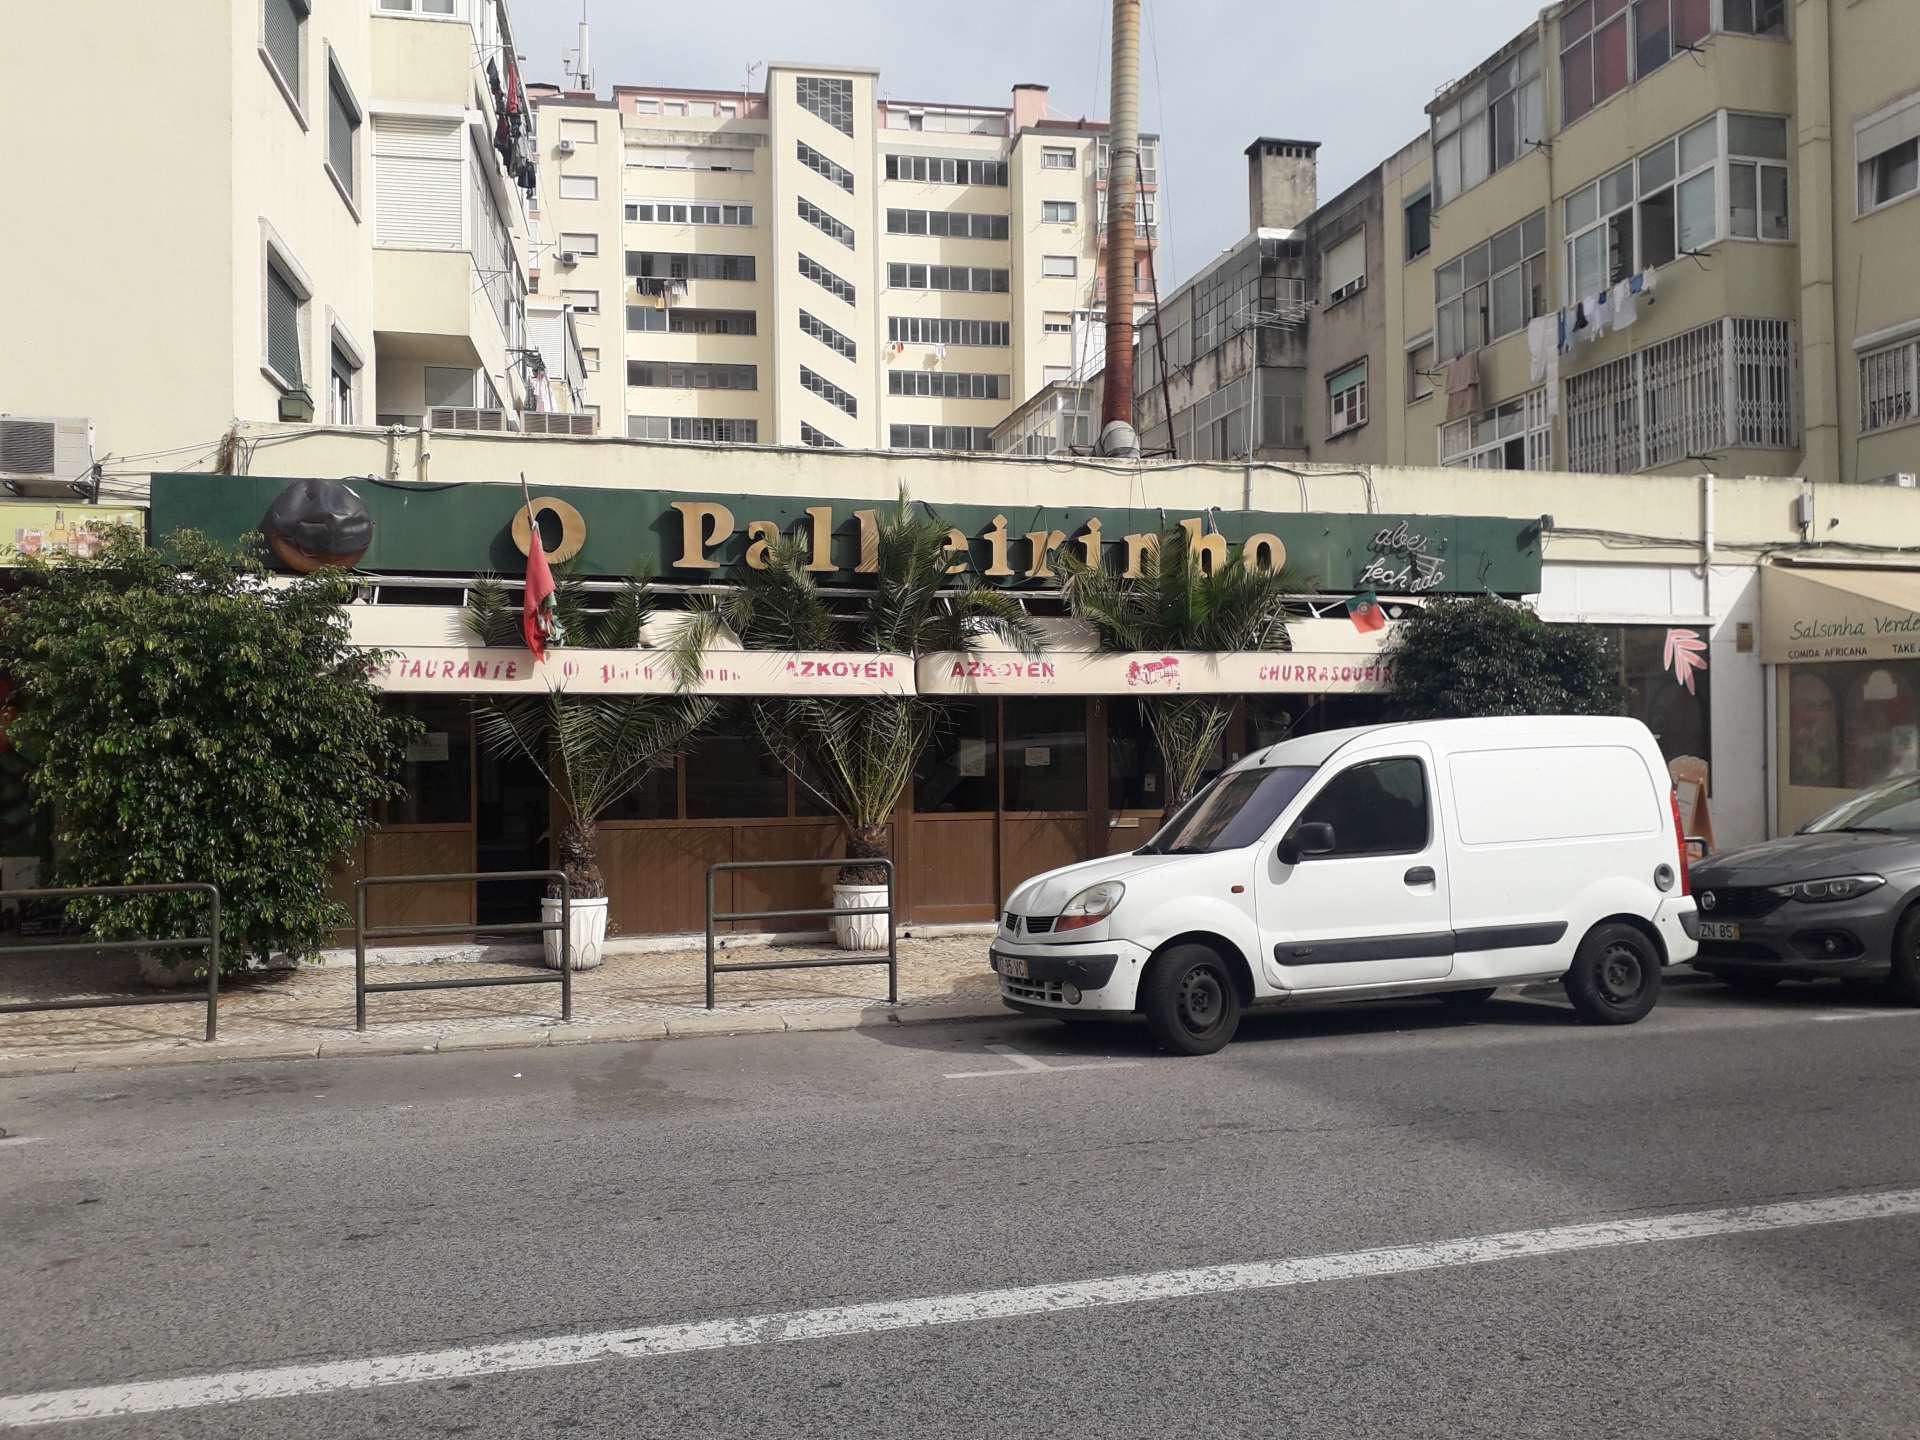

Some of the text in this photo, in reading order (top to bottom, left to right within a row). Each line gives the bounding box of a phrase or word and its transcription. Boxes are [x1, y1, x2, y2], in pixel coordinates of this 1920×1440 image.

[511, 496, 586, 565] O
[1789, 611, 1920, 640] Salsinha Verde
[1788, 649, 1820, 659] COMIDA
[1824, 646, 1868, 657] AFRICANA
[1892, 643, 1916, 654] TAKE
[786, 661, 894, 678] AZKOYEN
[951, 661, 1055, 678] AZKOYEN
[1258, 665, 1393, 682] CHURRASQUEIR
